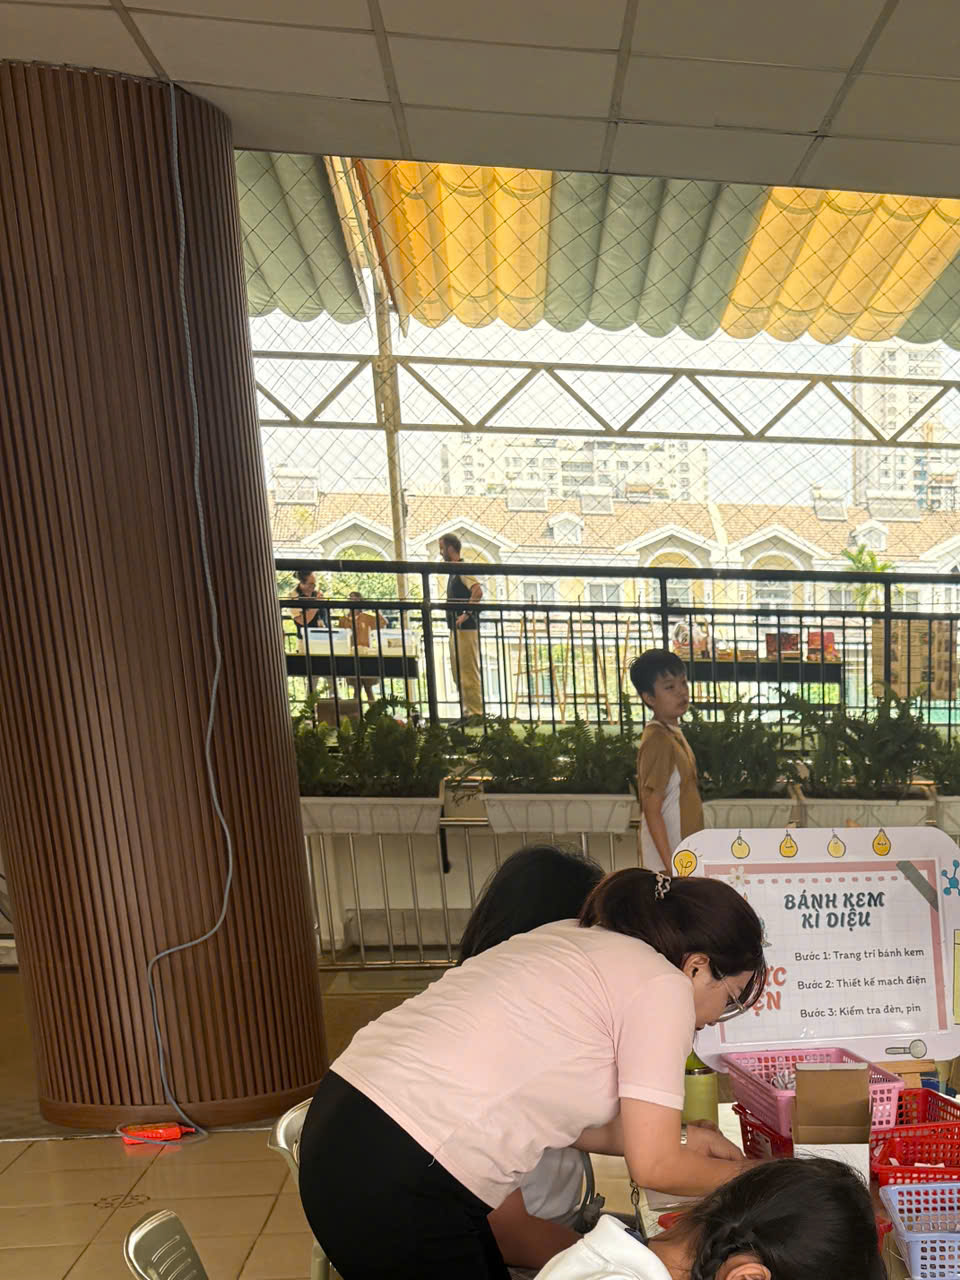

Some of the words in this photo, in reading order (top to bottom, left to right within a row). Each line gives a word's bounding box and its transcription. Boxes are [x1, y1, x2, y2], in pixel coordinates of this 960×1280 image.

[784, 889, 838, 910] BÁNH
[843, 891, 885, 909] KEM
[801, 908, 820, 929] KÌ
[826, 907, 871, 932] DIỆU
[794, 951, 820, 961] Bước
[823, 951, 831, 960] 1:
[833, 950, 861, 962] Trang
[877, 948, 902, 958] bánh
[904, 947, 925, 957] kem
[797, 980, 823, 990] Bước
[825, 979, 834, 989] 2:
[836, 978, 861, 988] Thiết
[906, 975, 927, 986] điện
[800, 1007, 826, 1018] Bước
[828, 1007, 837, 1016] 3:
[866, 1006, 881, 1014] tra
[883, 1003, 904, 1013] đèn,
[906, 1002, 921, 1014] pin
